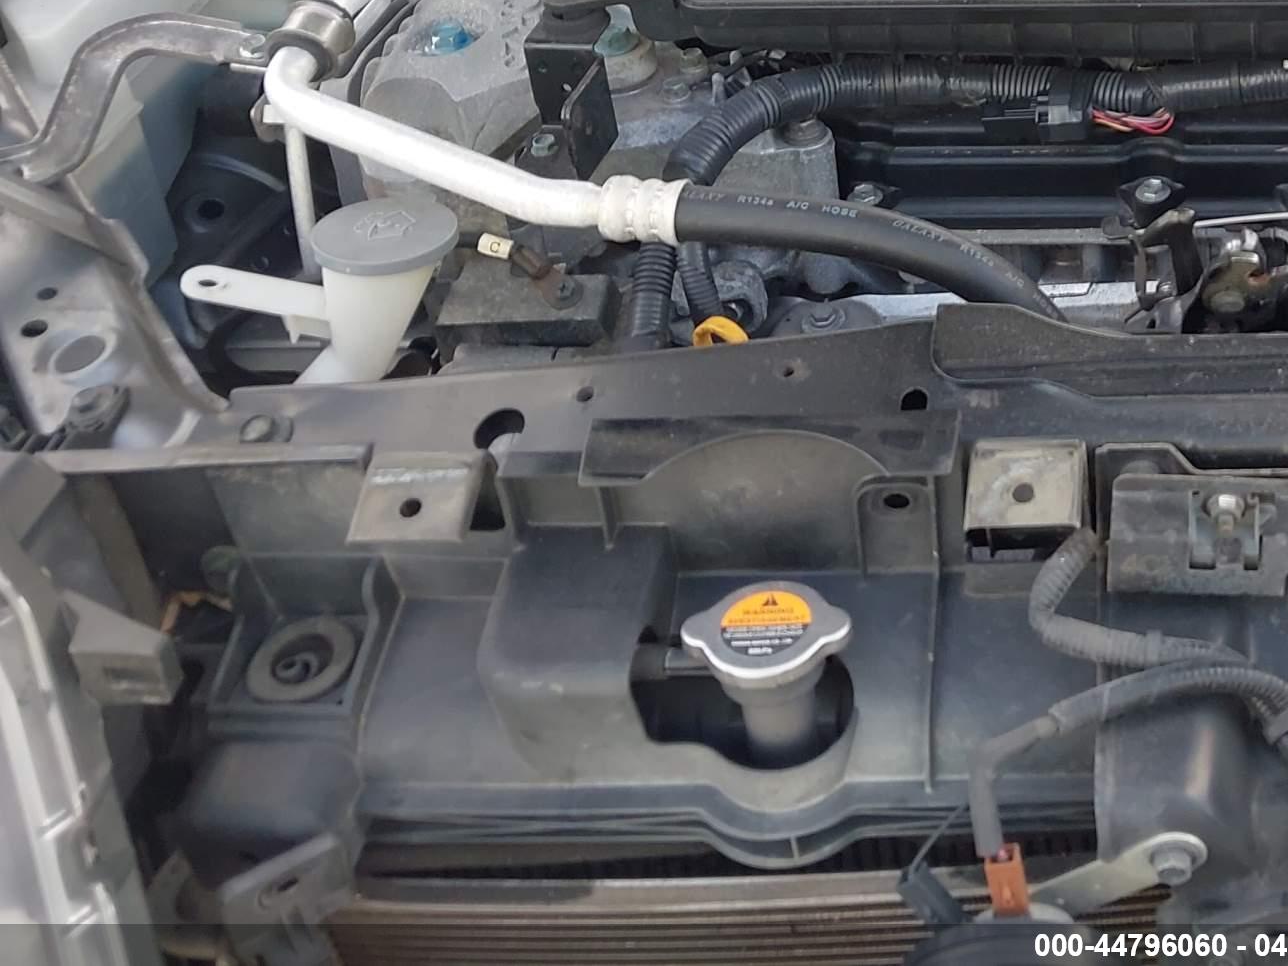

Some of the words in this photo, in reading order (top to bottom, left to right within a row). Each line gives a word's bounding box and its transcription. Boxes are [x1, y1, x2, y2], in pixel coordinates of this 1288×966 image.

[786, 201, 809, 211] A/C
[821, 204, 858, 218] HOSE
[489, 241, 501, 254] C
